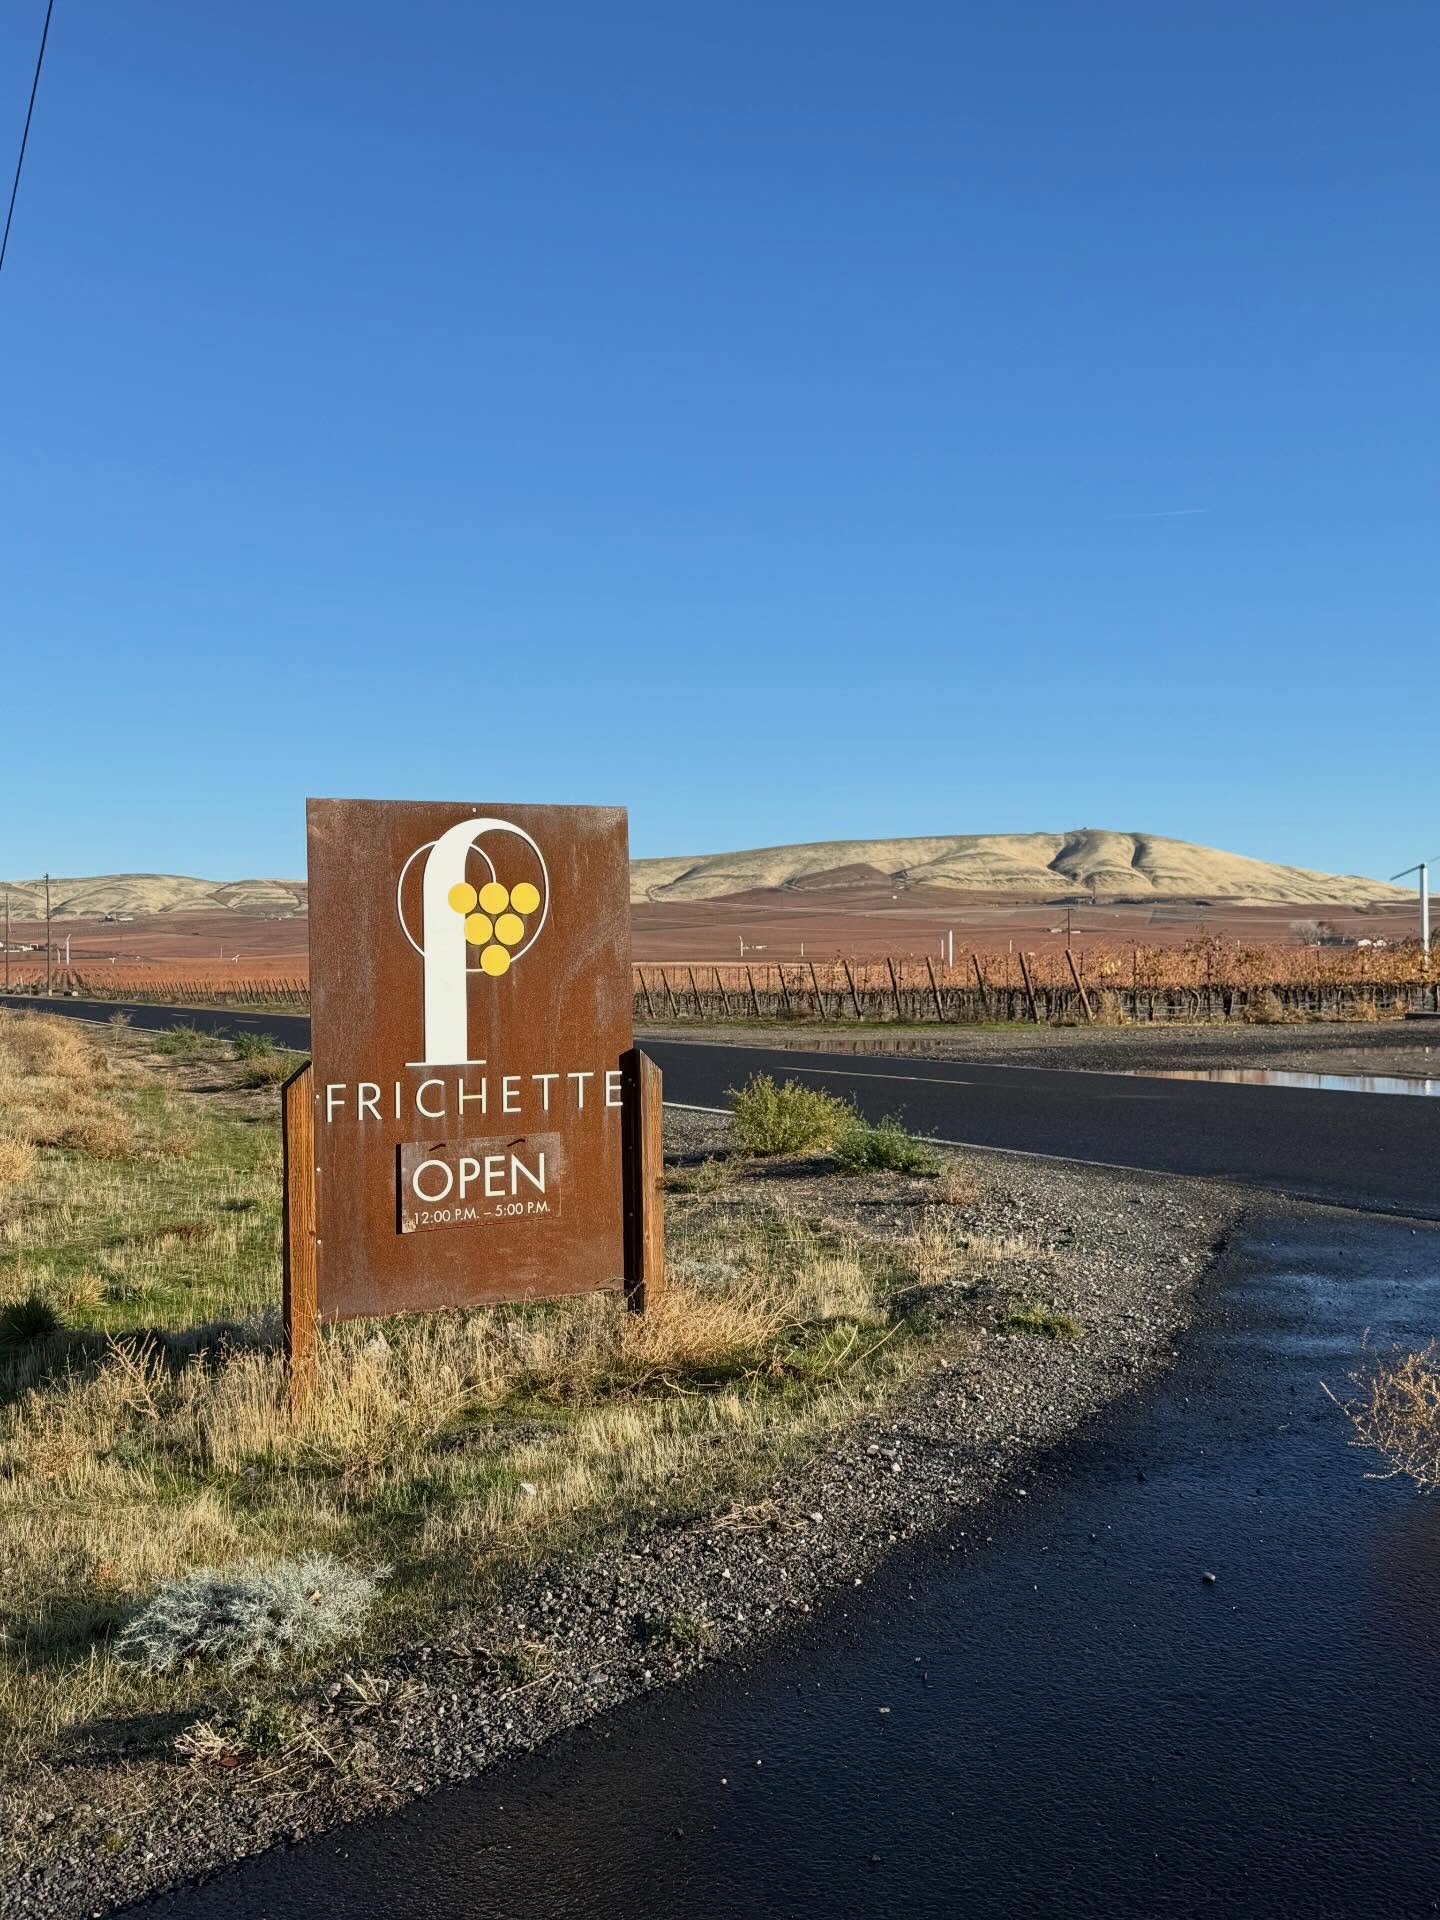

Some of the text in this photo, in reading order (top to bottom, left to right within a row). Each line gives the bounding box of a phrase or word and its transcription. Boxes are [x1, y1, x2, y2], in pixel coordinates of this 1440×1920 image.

[326, 1070, 624, 1123] FRICHETTE
[412, 1152, 545, 1201] OPEN
[414, 1209, 451, 1225] 12:00
[455, 1207, 480, 1221] P.M.
[495, 1202, 524, 1217] 5:00
[527, 1200, 551, 1214] P.M.
